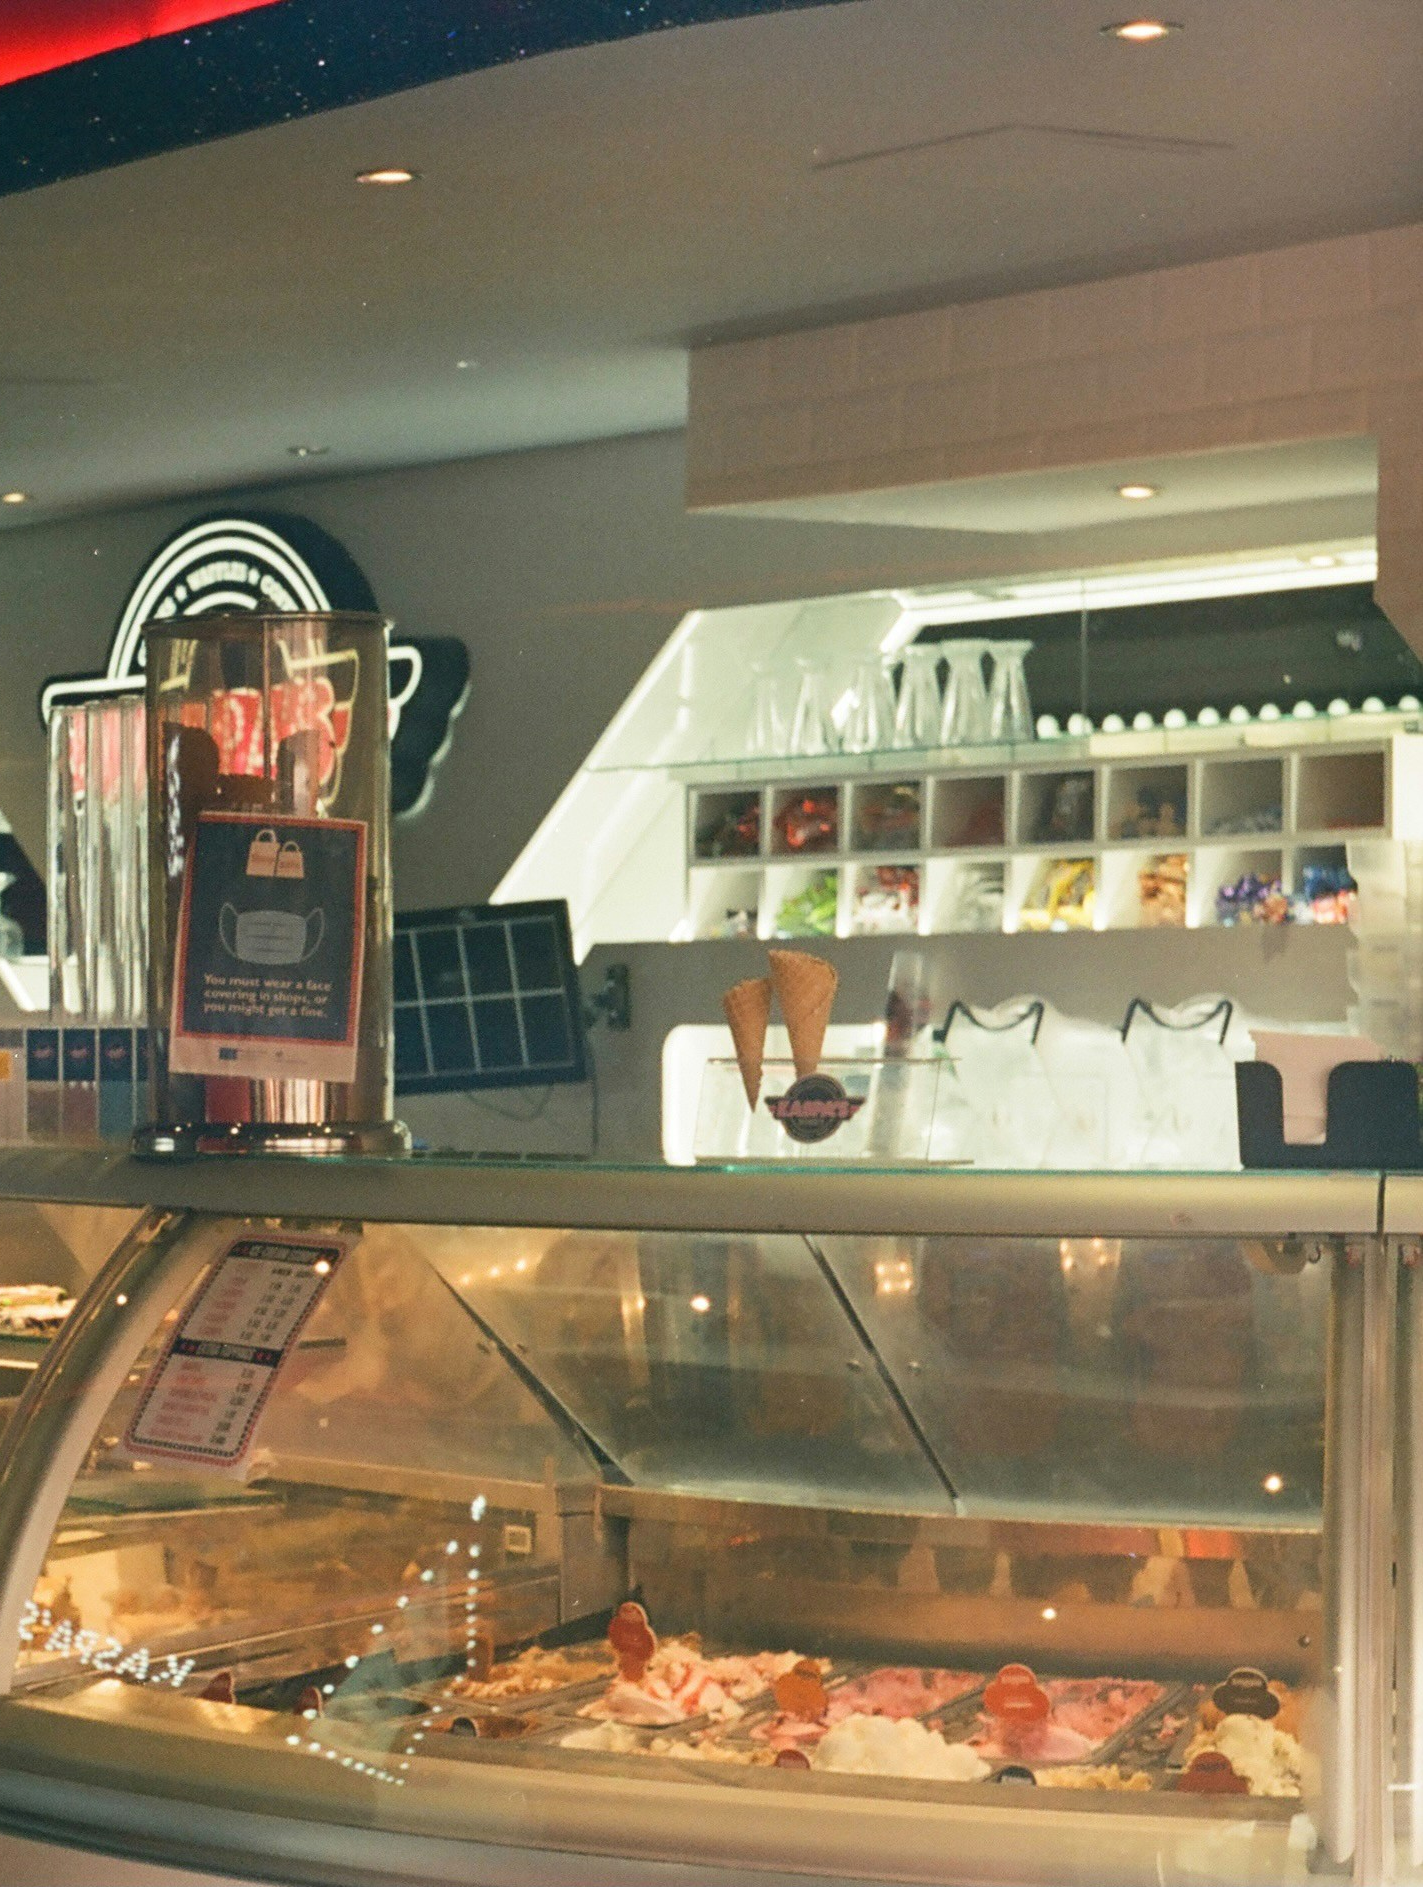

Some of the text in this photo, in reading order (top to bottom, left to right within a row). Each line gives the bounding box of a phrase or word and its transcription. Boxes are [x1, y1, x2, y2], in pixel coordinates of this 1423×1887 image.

[204, 972, 332, 991] You must wear a face
[204, 989, 257, 1004] covering
[259, 990, 271, 1002] in
[313, 995, 328, 1004] or
[204, 1002, 226, 1013] you
[228, 1002, 264, 1016] might
[267, 1006, 288, 1018] get
[290, 1008, 298, 1017] a
